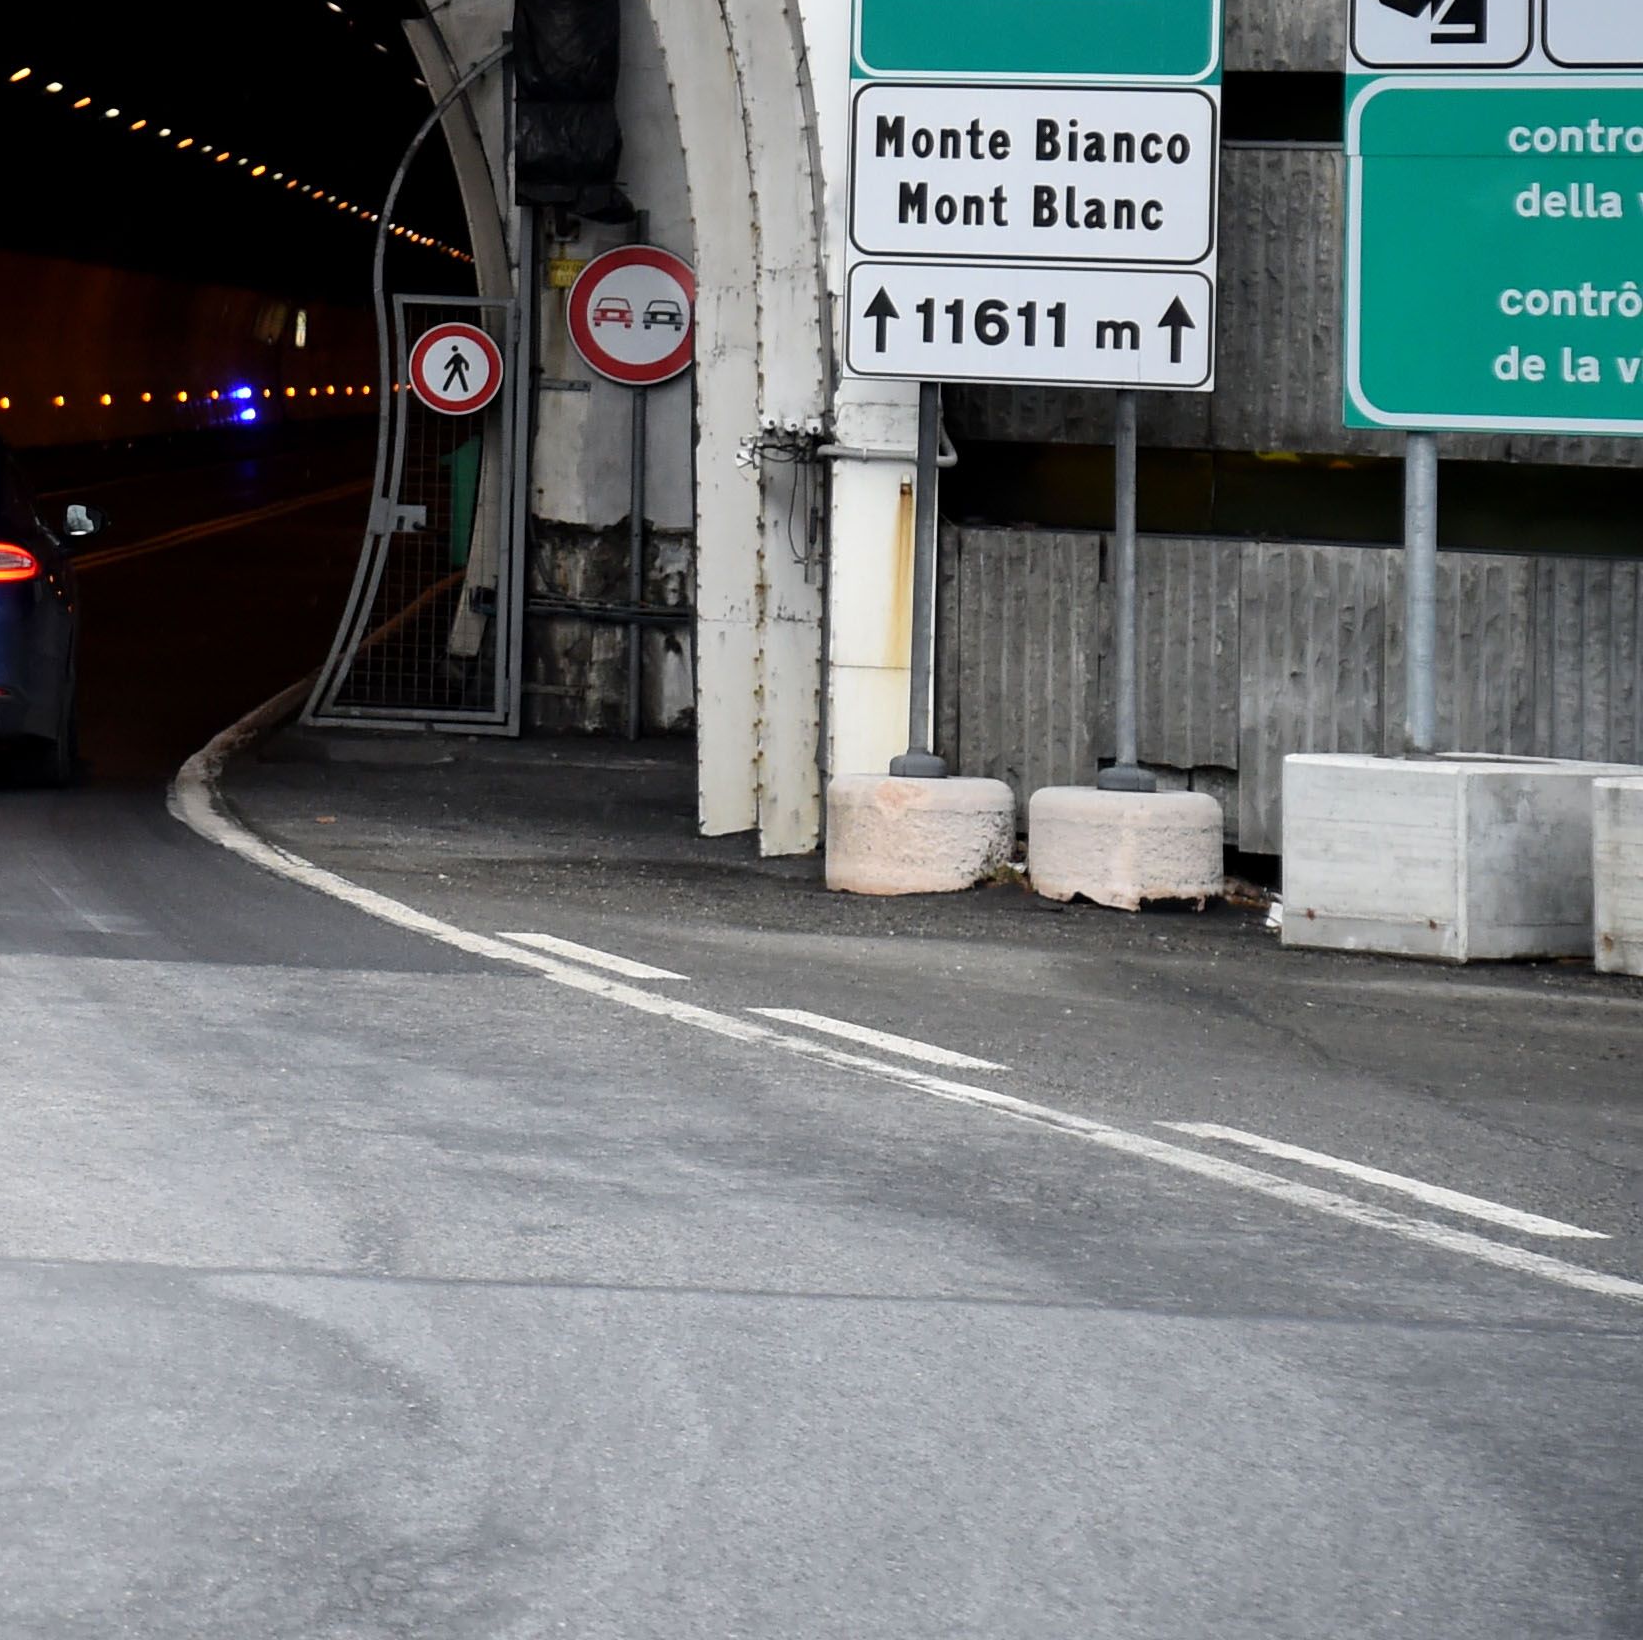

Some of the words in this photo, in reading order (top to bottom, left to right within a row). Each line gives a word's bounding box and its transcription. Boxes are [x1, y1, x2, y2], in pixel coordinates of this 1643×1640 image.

[875, 115, 1011, 160] Monte
[1034, 118, 1191, 164] Bianco
[898, 181, 1009, 227] Mont
[1032, 184, 1164, 230] Blanc
[1516, 182, 1623, 218] della
[1500, 281, 1643, 318] contrô
[915, 297, 1067, 348] 11611
[1096, 320, 1141, 350] m
[1494, 345, 1546, 381] de
[1562, 346, 1601, 382] la
